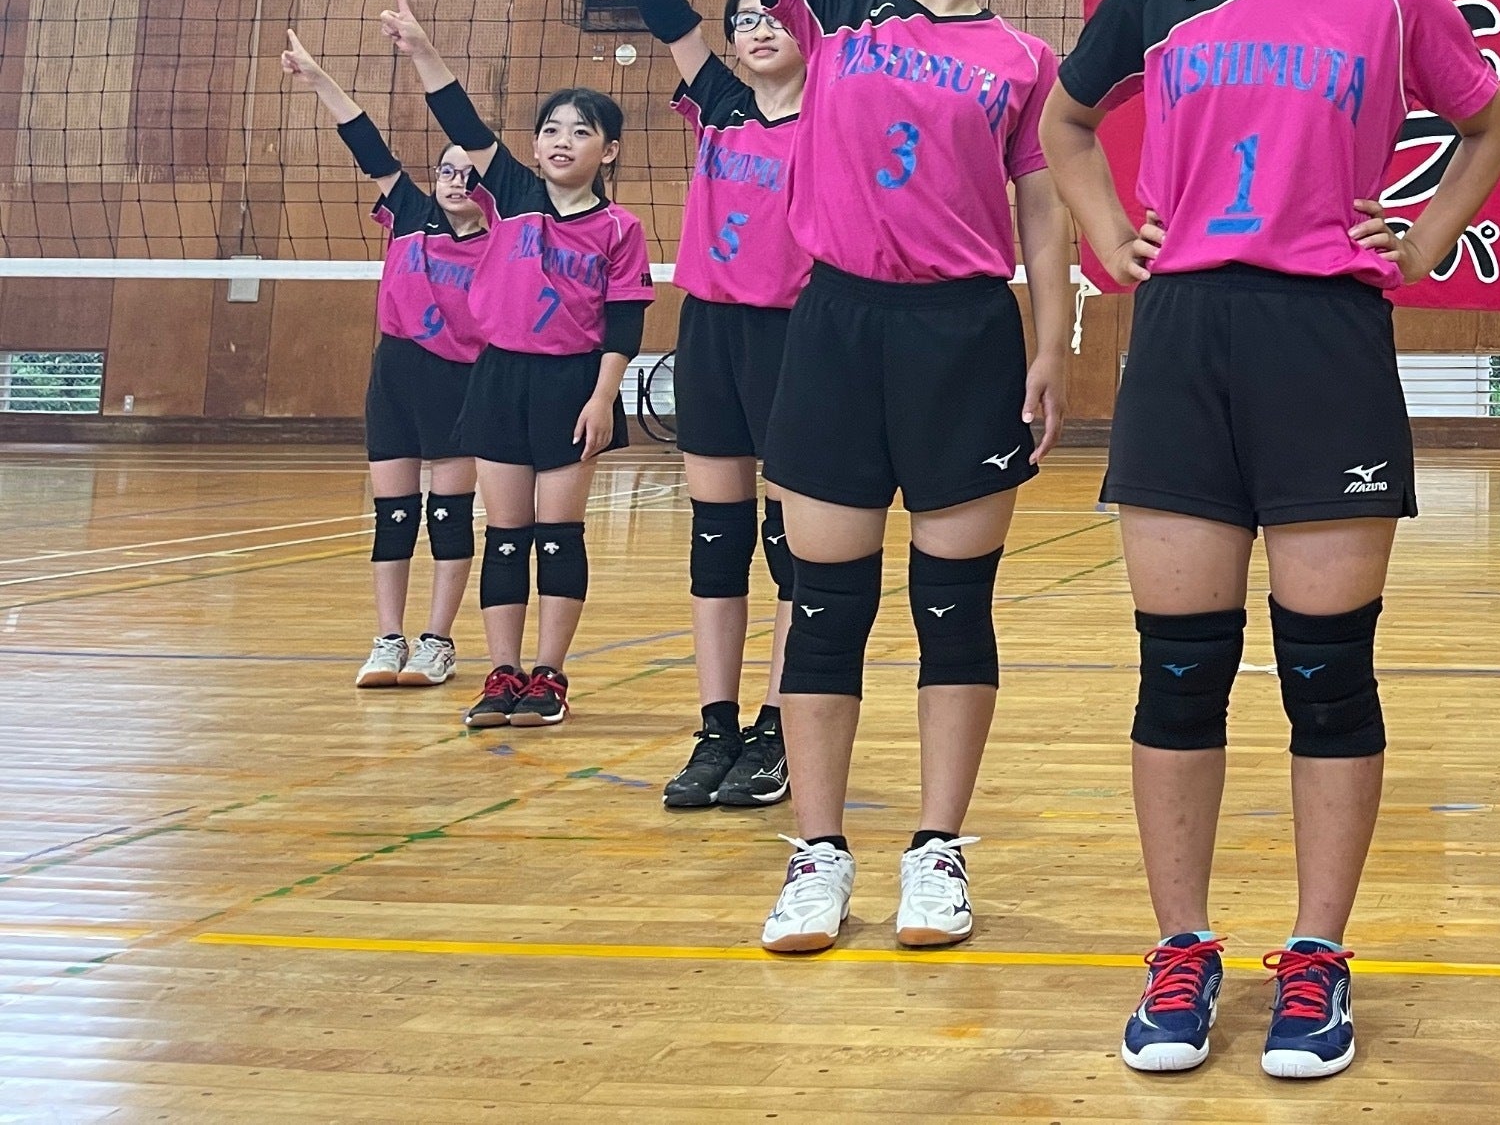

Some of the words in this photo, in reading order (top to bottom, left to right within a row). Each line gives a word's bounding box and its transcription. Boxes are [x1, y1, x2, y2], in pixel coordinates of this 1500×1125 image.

[1161, 41, 1367, 129] NISHIMUTA
[876, 121, 919, 190] 3
[1224, 132, 1260, 215] 1
[709, 211, 749, 263] 5
[413, 304, 446, 341] 9
[532, 286, 562, 334] 7
